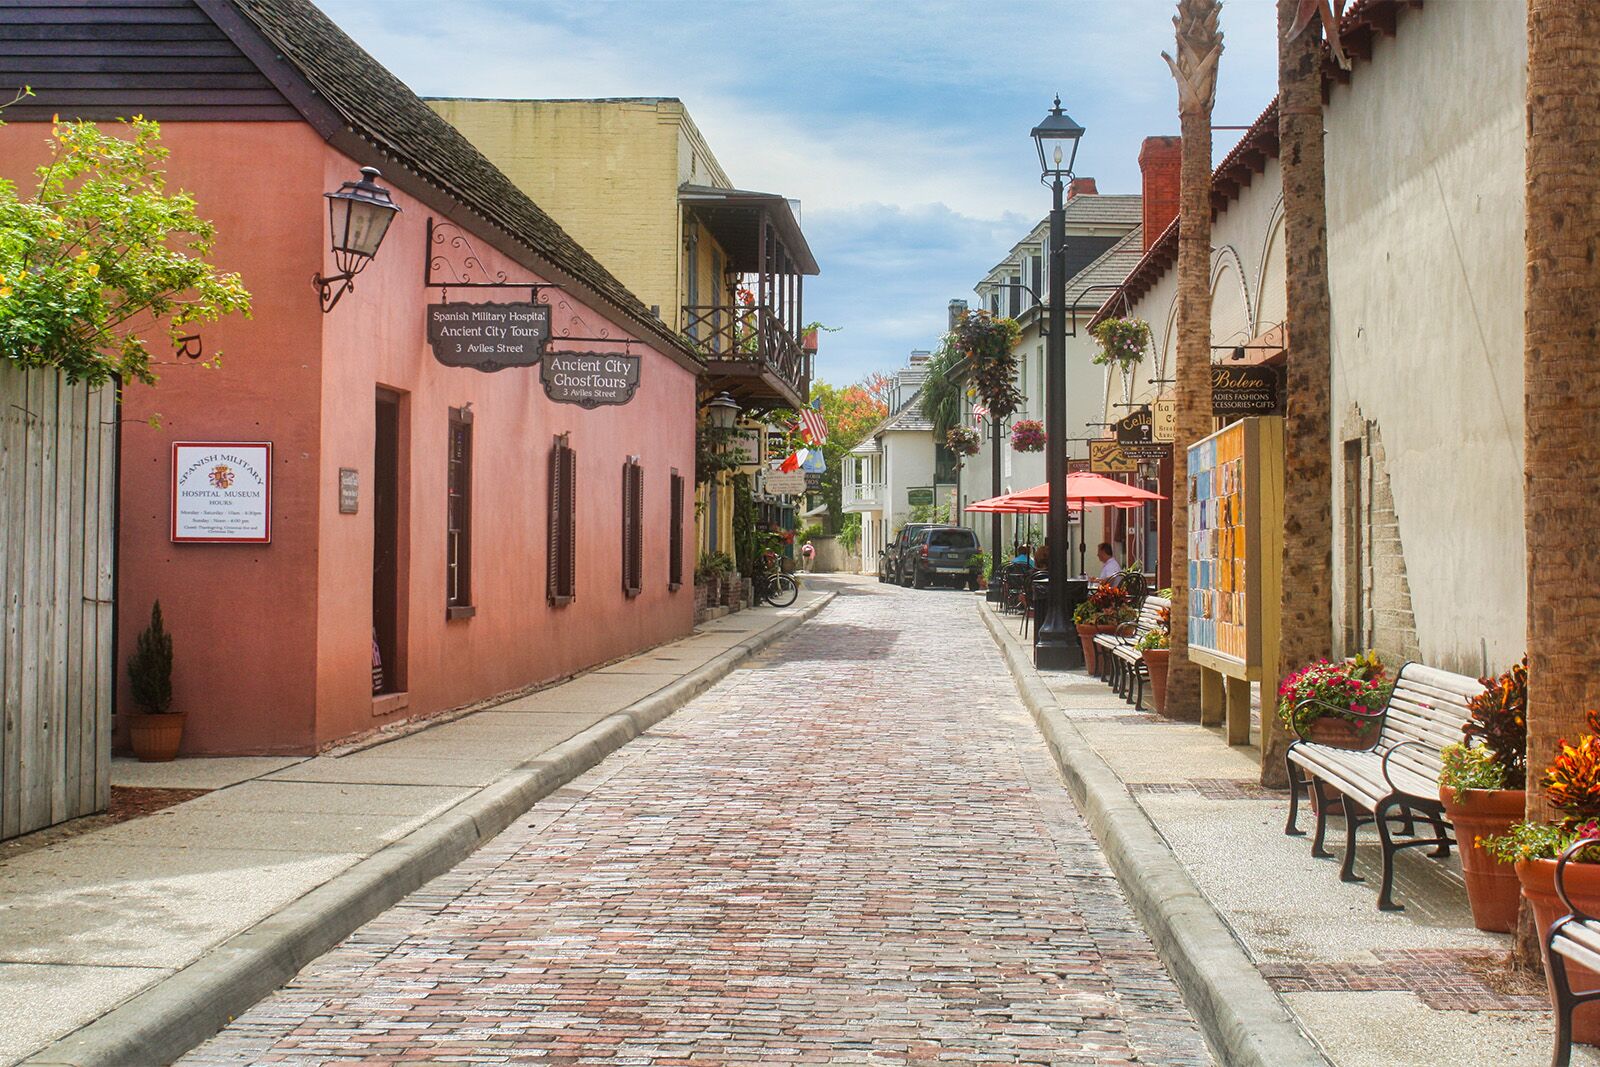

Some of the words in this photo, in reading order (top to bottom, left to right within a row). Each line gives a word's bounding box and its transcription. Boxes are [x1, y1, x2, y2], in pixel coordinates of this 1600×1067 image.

[433, 312, 469, 322] Spanish
[472, 312, 506, 322] Military
[509, 312, 545, 323] Hospital
[440, 326, 481, 336] Ancient
[485, 326, 507, 338] City
[510, 326, 539, 336] Tours
[456, 344, 462, 353] 3
[467, 344, 494, 353] Aviles
[497, 344, 523, 353] Street
[550, 358, 600, 372] Ancient
[605, 359, 631, 376] City
[1212, 369, 1264, 388] Bolero
[563, 388, 568, 396] 3
[570, 389, 592, 397] Aviles
[594, 389, 616, 398] Street
[1123, 414, 1152, 430] Cella
[179, 454, 218, 486] SPANISH
[220, 454, 264, 486] MILITARY
[182, 490, 220, 498] HOSPITAL
[224, 490, 260, 498] MUSEUM
